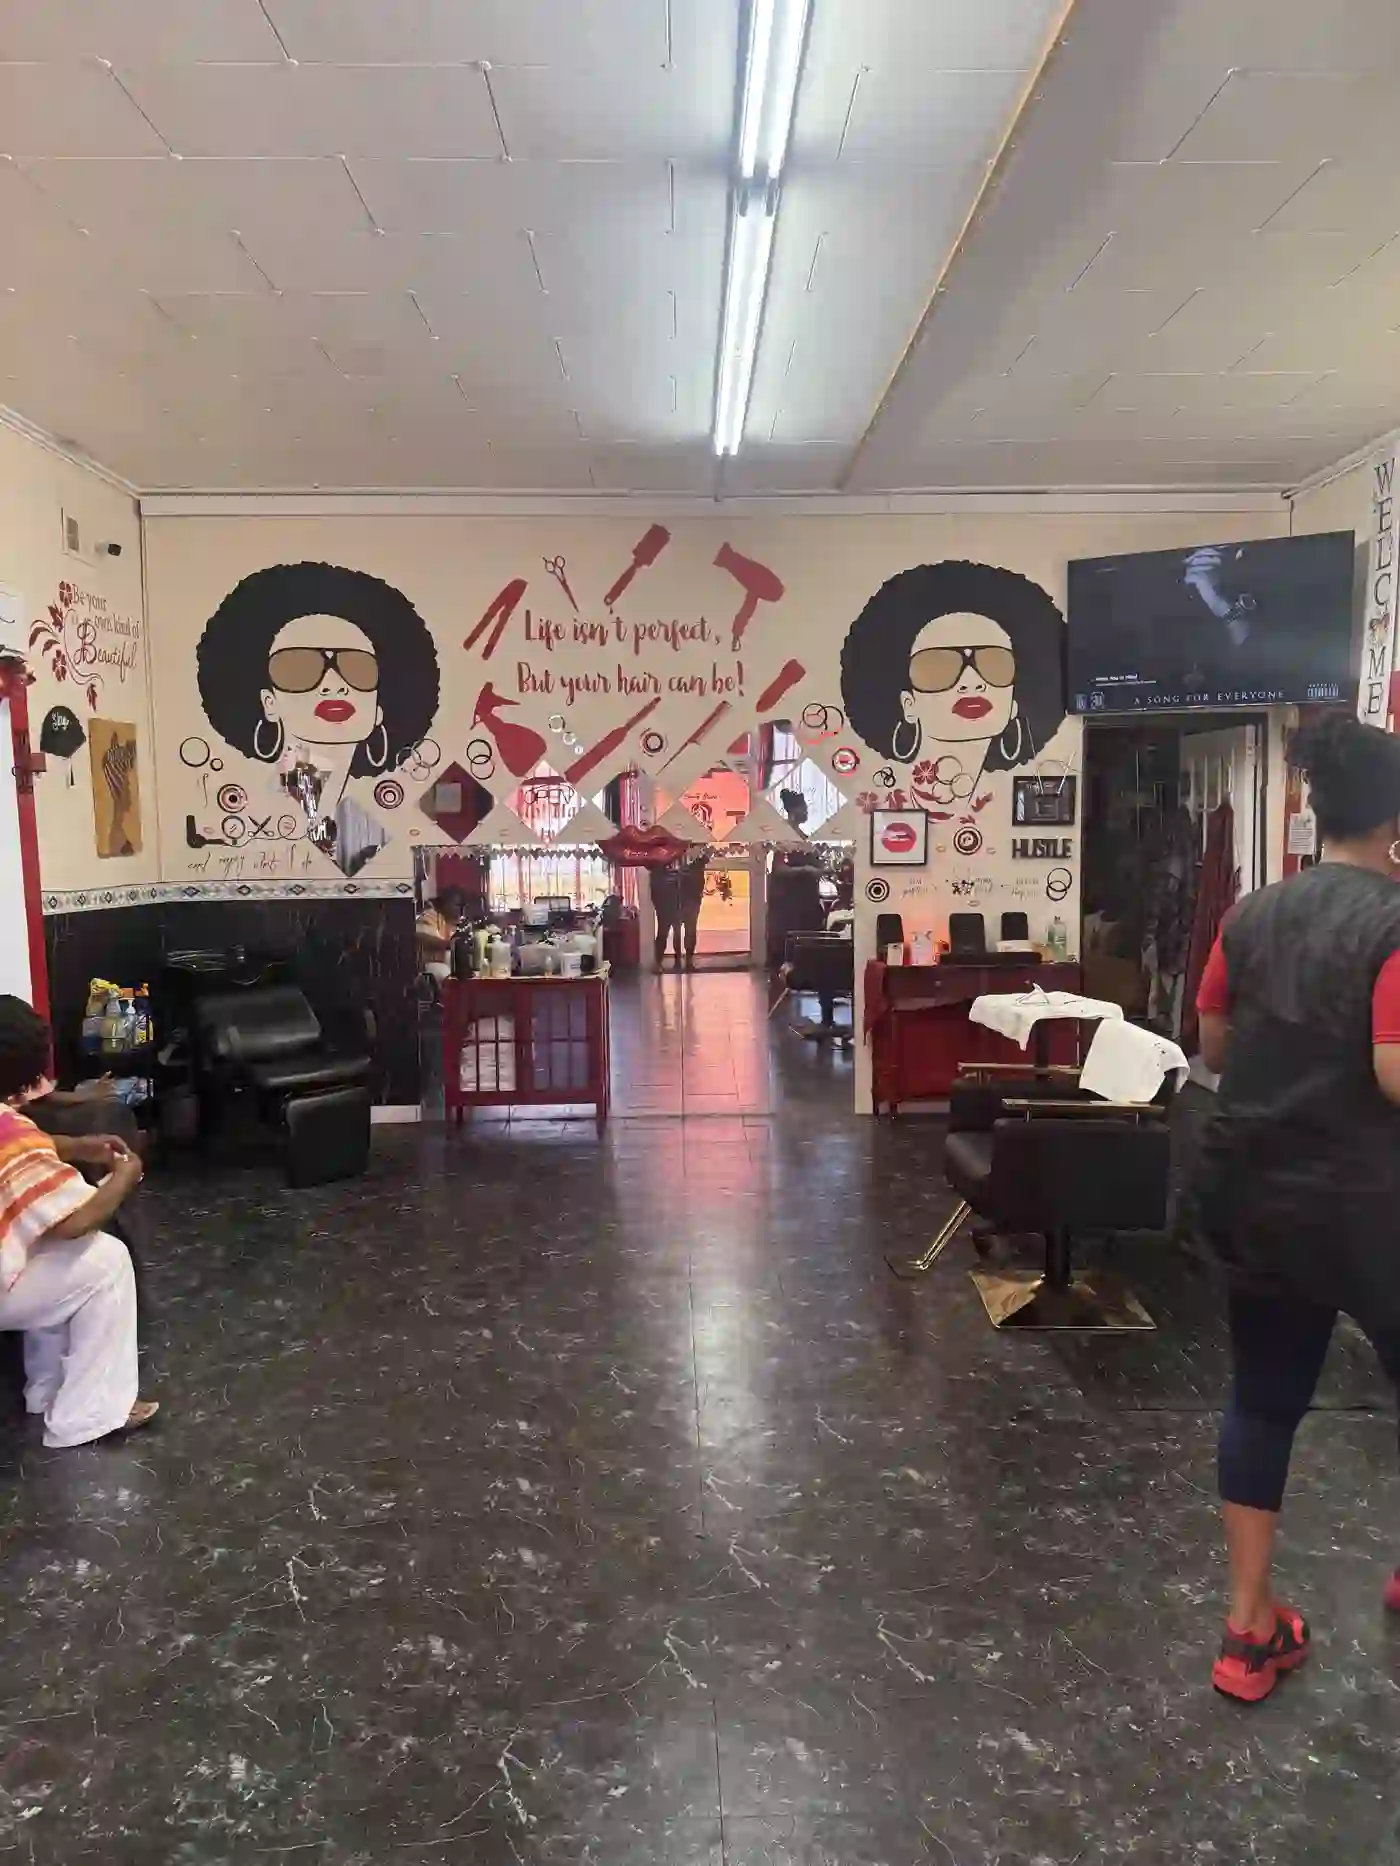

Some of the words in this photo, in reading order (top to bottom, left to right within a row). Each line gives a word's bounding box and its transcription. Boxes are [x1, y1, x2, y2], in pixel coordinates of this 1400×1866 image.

[1367, 457, 1396, 715] WELCME
[73, 620, 137, 683] Beautiful
[524, 609, 567, 651] Life
[633, 616, 722, 656] perfect,
[517, 661, 555, 694] But
[560, 671, 611, 707] your
[617, 663, 662, 696] hair
[667, 674, 709, 697] can
[711, 660, 745, 697] be!
[1147, 695, 1181, 704] SONG
[1186, 693, 1210, 702] FOR
[1217, 690, 1286, 701] EVERYONE
[1011, 838, 1073, 859] HUSTLE
